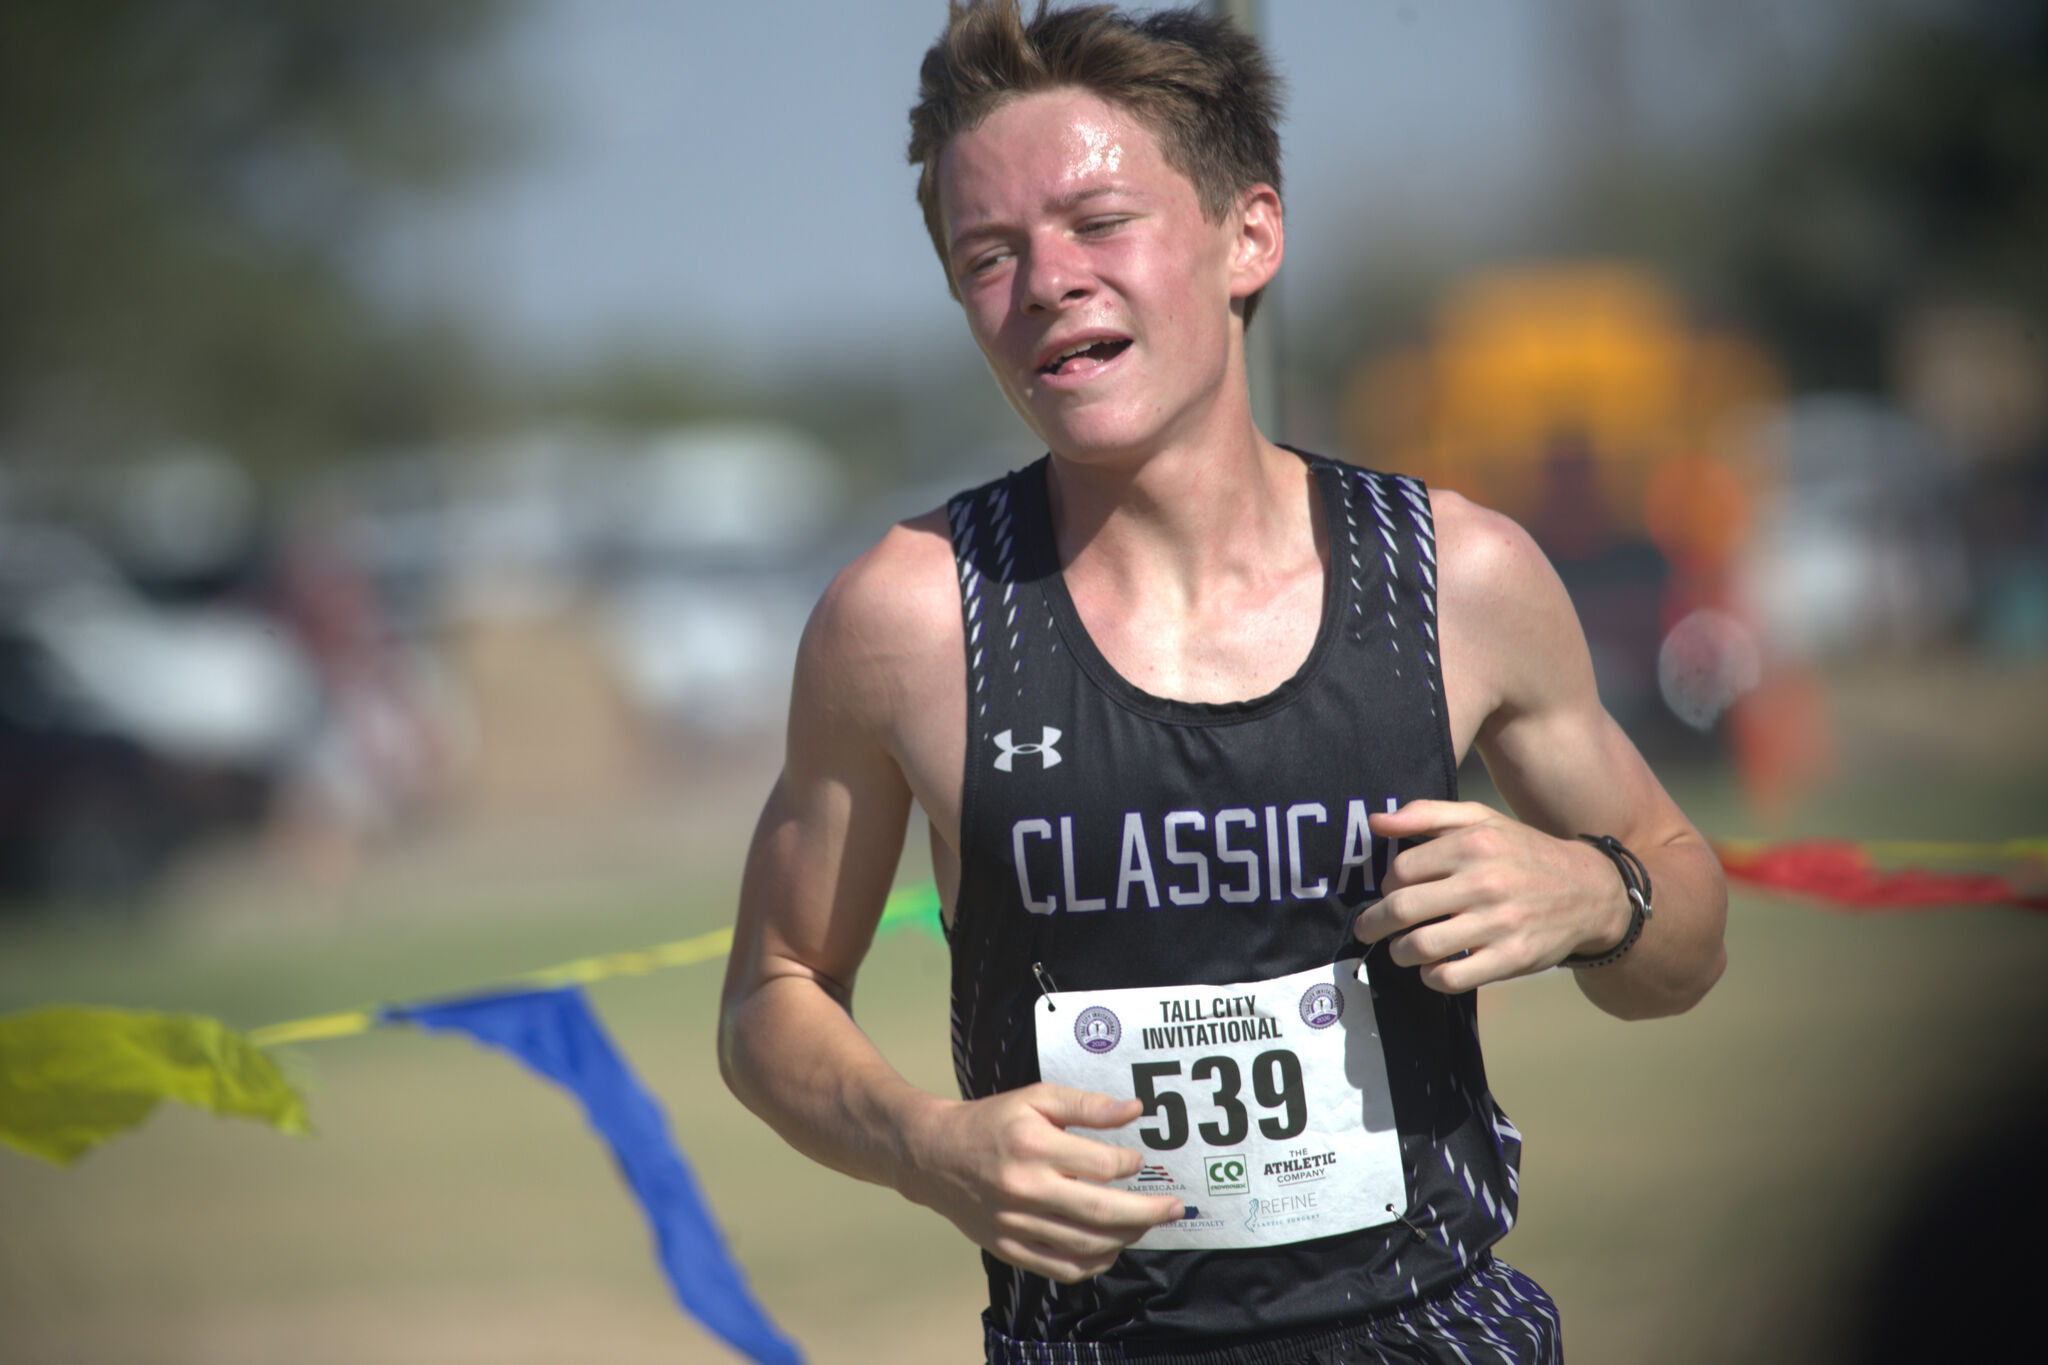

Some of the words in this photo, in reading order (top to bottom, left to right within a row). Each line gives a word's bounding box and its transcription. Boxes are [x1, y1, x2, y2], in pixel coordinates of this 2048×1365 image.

[1159, 999, 1207, 1024] TALL
[1211, 995, 1257, 1019] CITY
[1142, 1017, 1283, 1050] INVITATIONAL
[1131, 1049, 1308, 1151] 539
[1263, 1152, 1337, 1176] ATHLETIC
[1289, 1148, 1308, 1157] THE
[1127, 1183, 1187, 1192] AMERICANA
[1277, 1168, 1326, 1184] COMPANY
[1260, 1192, 1319, 1215] REFINE
